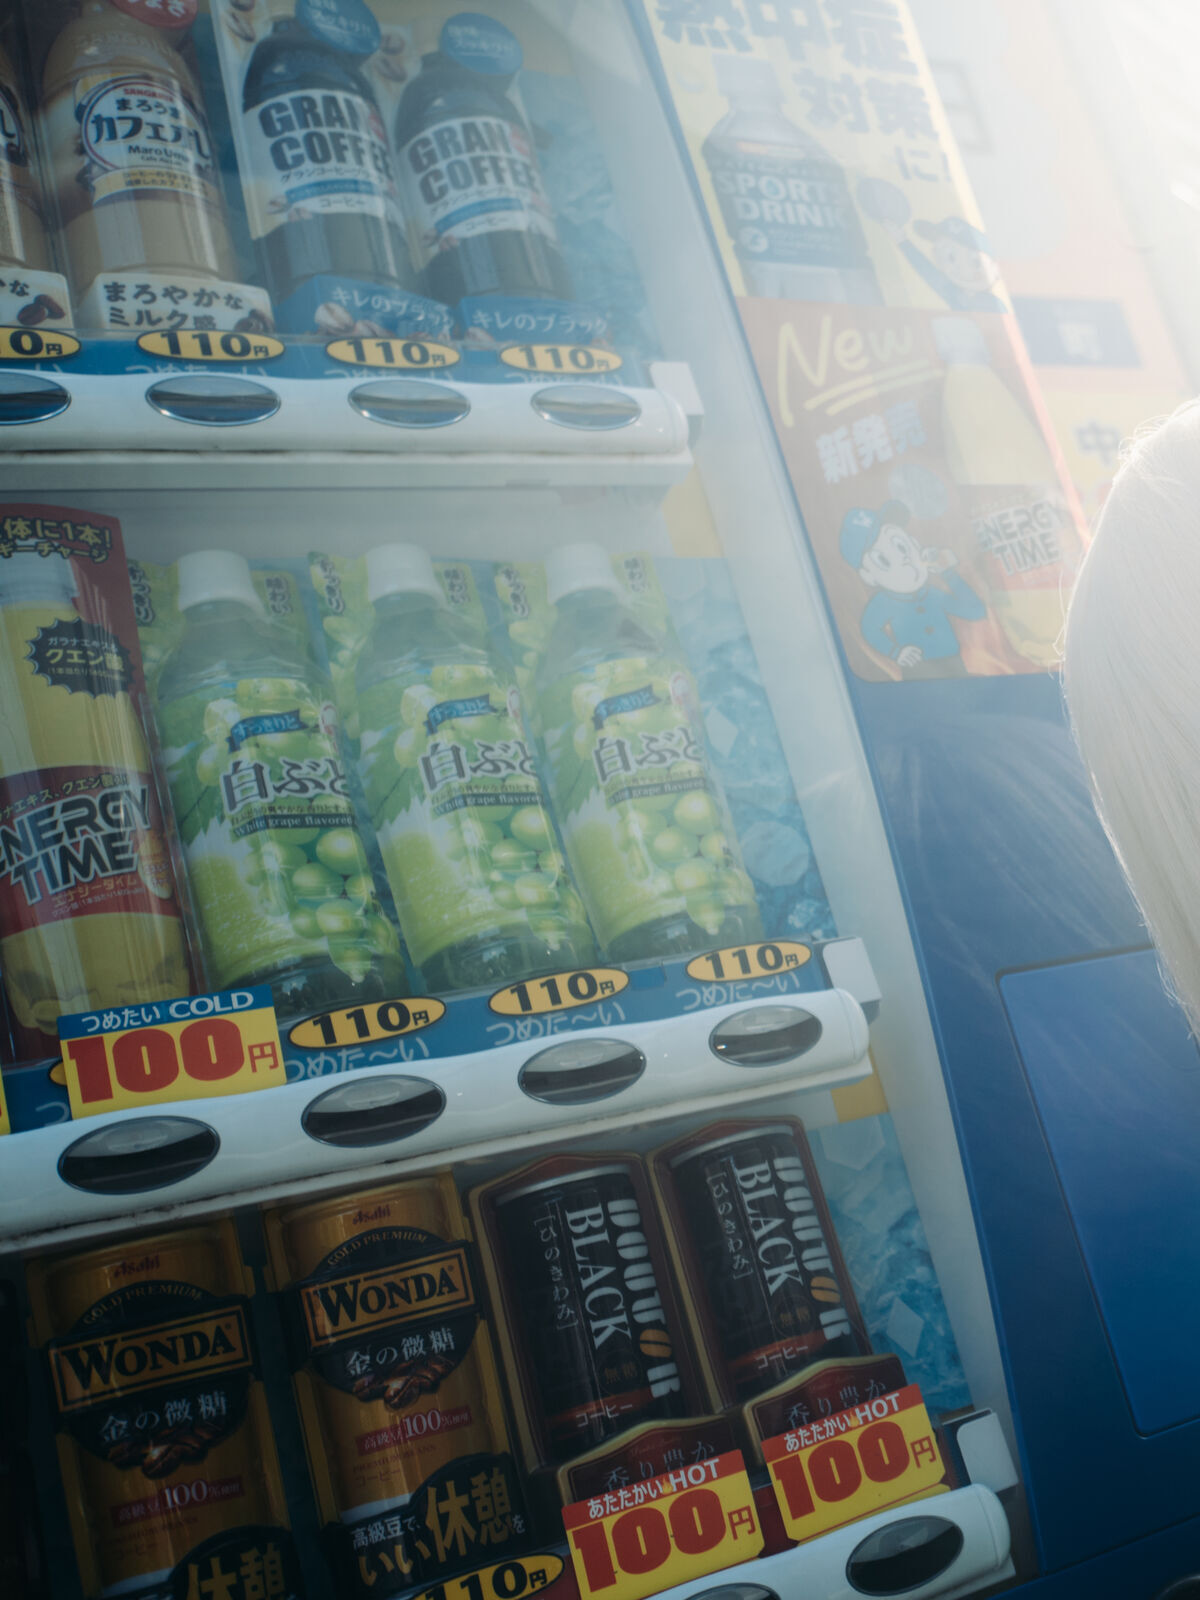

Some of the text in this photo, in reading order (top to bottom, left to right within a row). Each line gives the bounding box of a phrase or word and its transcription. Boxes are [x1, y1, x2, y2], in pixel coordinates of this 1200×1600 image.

[103, 281, 244, 309] まろやかな
[109, 306, 217, 331] ミルク感
[160, 331, 270, 358] 110円
[346, 339, 446, 366] 110円
[520, 344, 609, 371] 110円
[777, 314, 914, 429] New
[815, 400, 929, 485] 新発売
[992, 530, 1062, 577] TIME
[268, 817, 301, 829] grape
[10, 830, 139, 906] TIME
[706, 942, 801, 979] 110円
[81, 991, 255, 1033] つめたい COLD
[510, 971, 616, 1013] 110円
[312, 1001, 430, 1046] 110円
[67, 1018, 280, 1105] 100円
[352, 1203, 392, 1227] Asahi
[732, 1159, 804, 1297] BLACK
[113, 1254, 161, 1280] Asahi
[326, 1230, 430, 1267] GOLD PREMIUM
[312, 1265, 460, 1328] WONDA
[565, 1203, 633, 1351] BLACK
[606, 1198, 682, 1400] DOUTOR
[61, 1323, 237, 1391] WONDA
[345, 1327, 457, 1378] 金の微糖
[755, 1344, 810, 1372] コーヒー
[100, 1390, 229, 1442] 金の微糖
[575, 1402, 634, 1433] コーヒー
[784, 1391, 901, 1453] あたたかい HOT
[587, 1457, 720, 1520] あたたかい HOT
[771, 1421, 938, 1520] 100円
[571, 1487, 758, 1594] 100円
